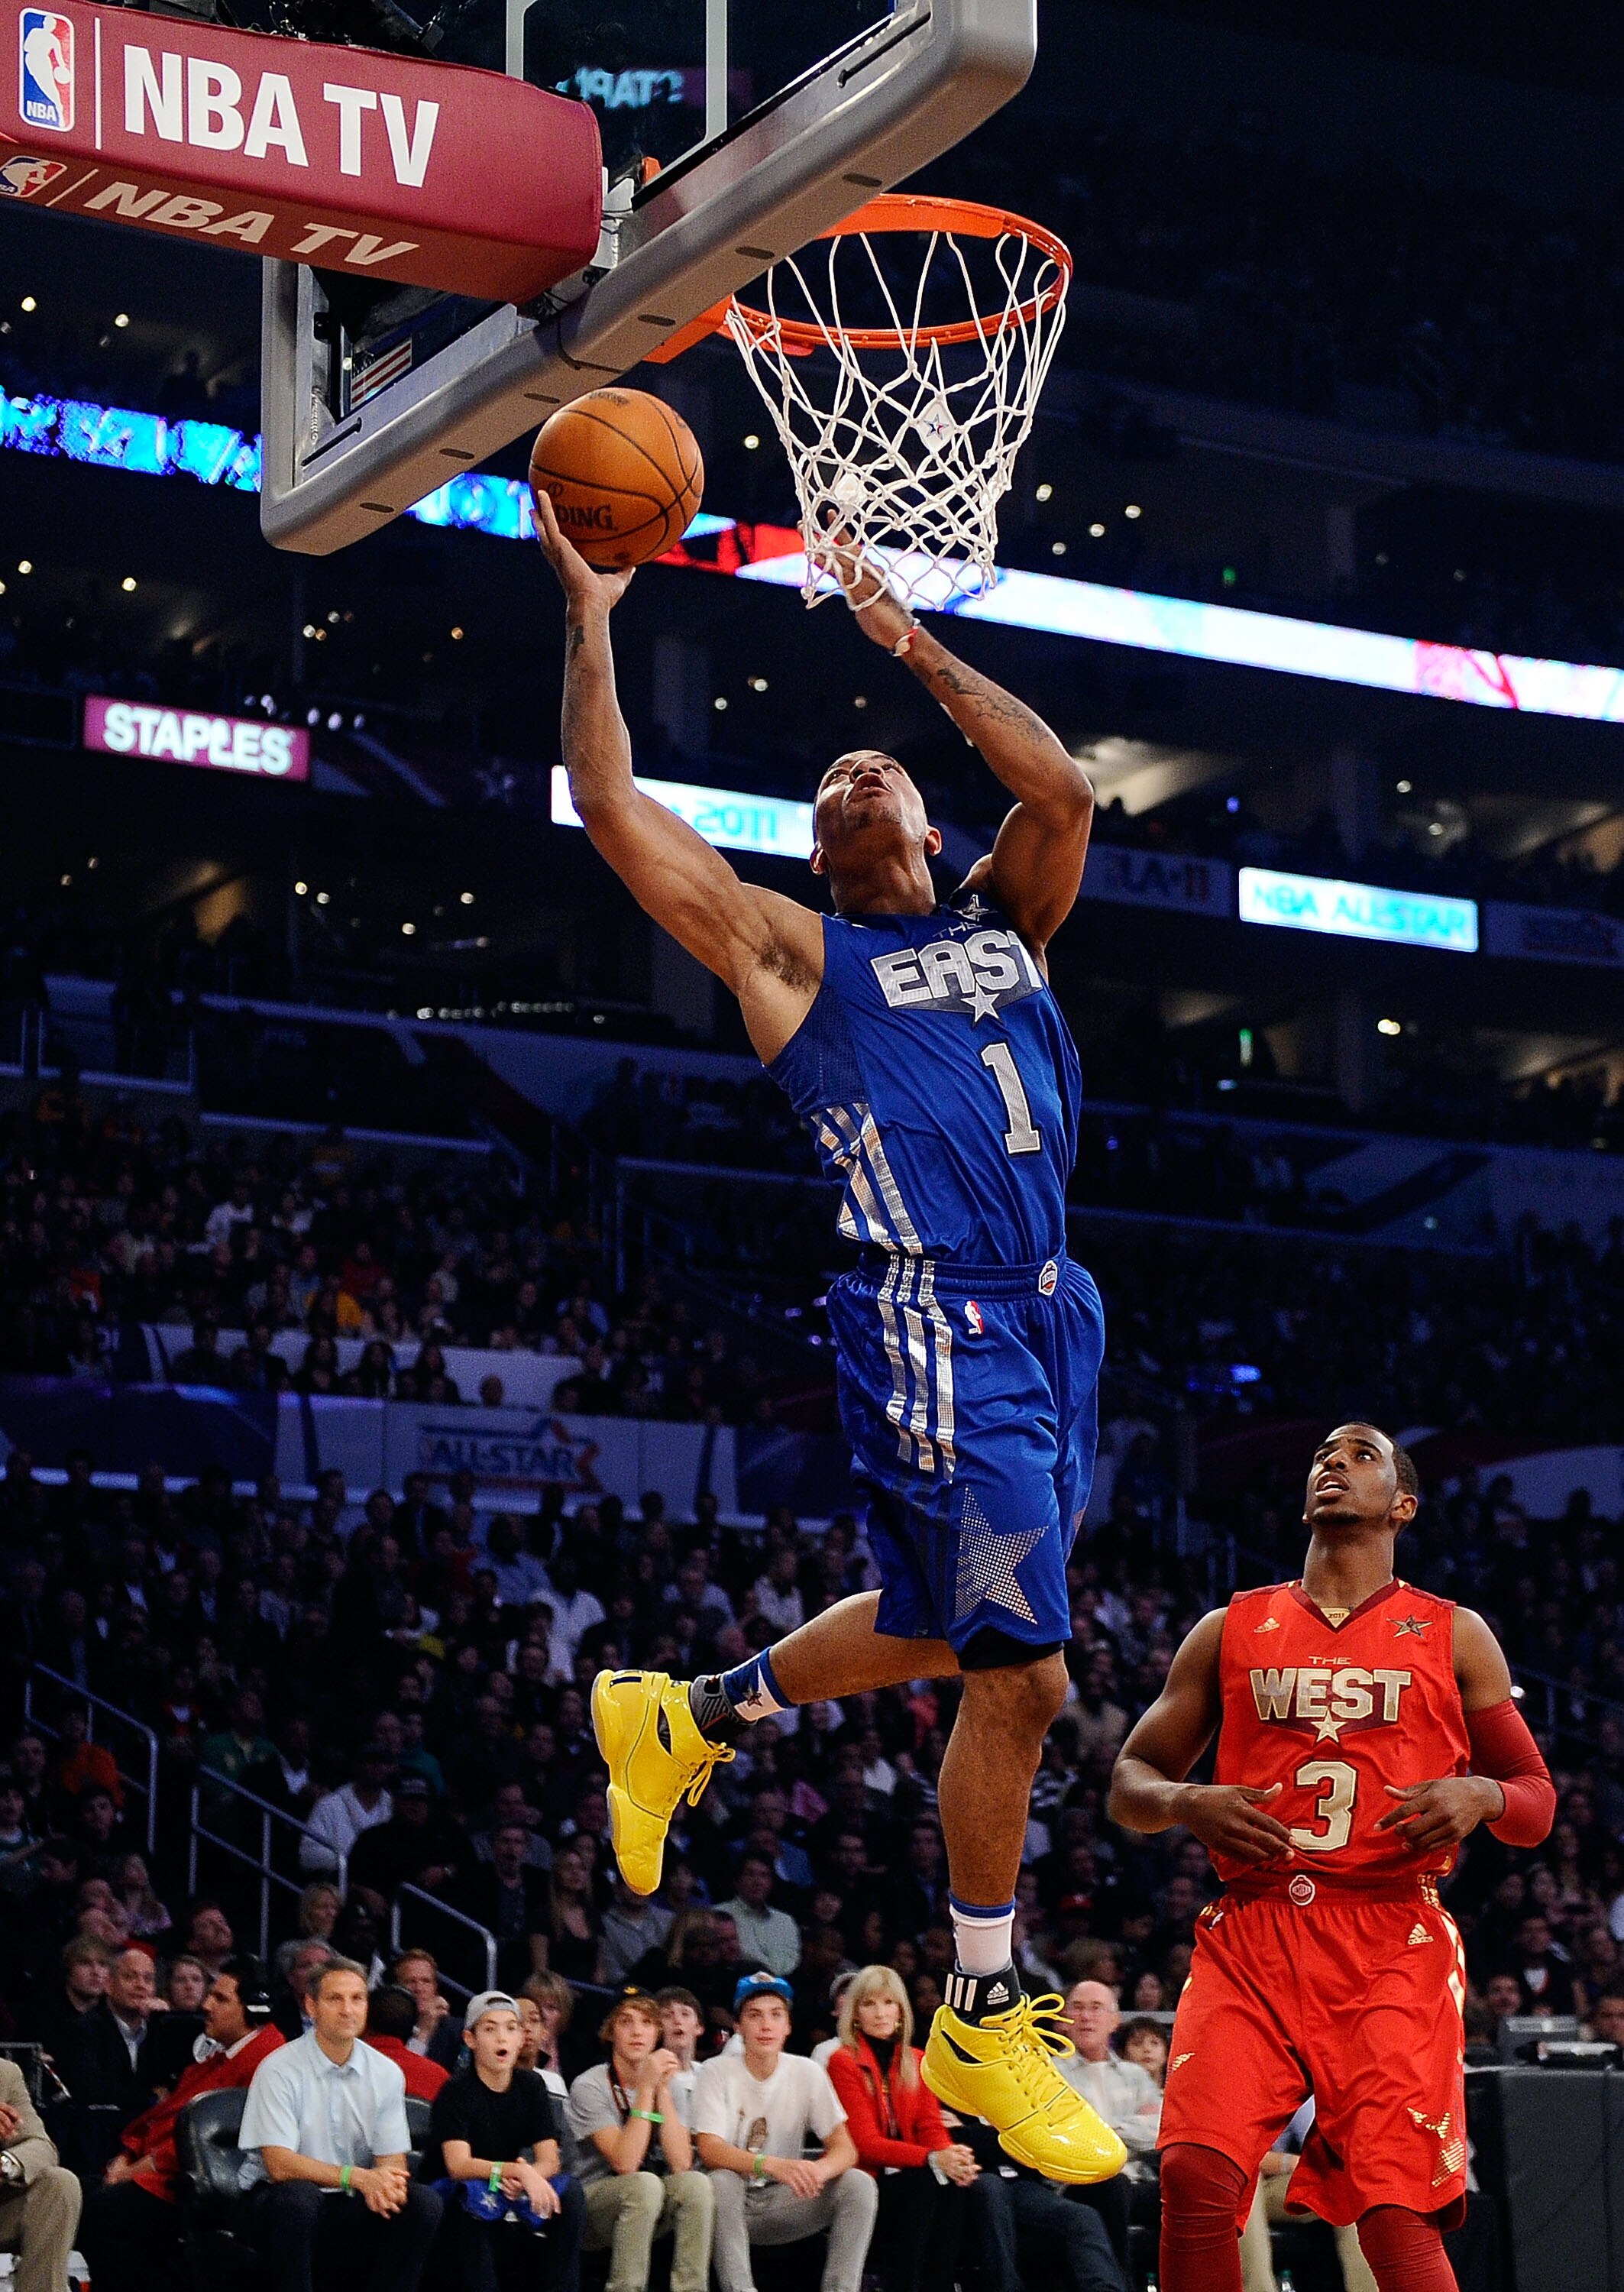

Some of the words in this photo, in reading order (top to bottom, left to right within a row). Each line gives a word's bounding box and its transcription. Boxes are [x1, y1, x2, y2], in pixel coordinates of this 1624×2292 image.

[27, 100, 57, 122] NBA
[125, 44, 309, 167] NBA
[323, 83, 440, 188] TV
[83, 182, 276, 244] NBA
[290, 223, 420, 266] TV
[555, 503, 613, 531] DING
[103, 702, 294, 775] STAPLES
[693, 799, 778, 842] 2011
[1252, 882, 1320, 918] NBA
[981, 1042, 1040, 1154] 1
[1308, 1656, 1351, 1665] THE
[1250, 1668, 1412, 1721] WEST
[1289, 1760, 1357, 1851] 3
